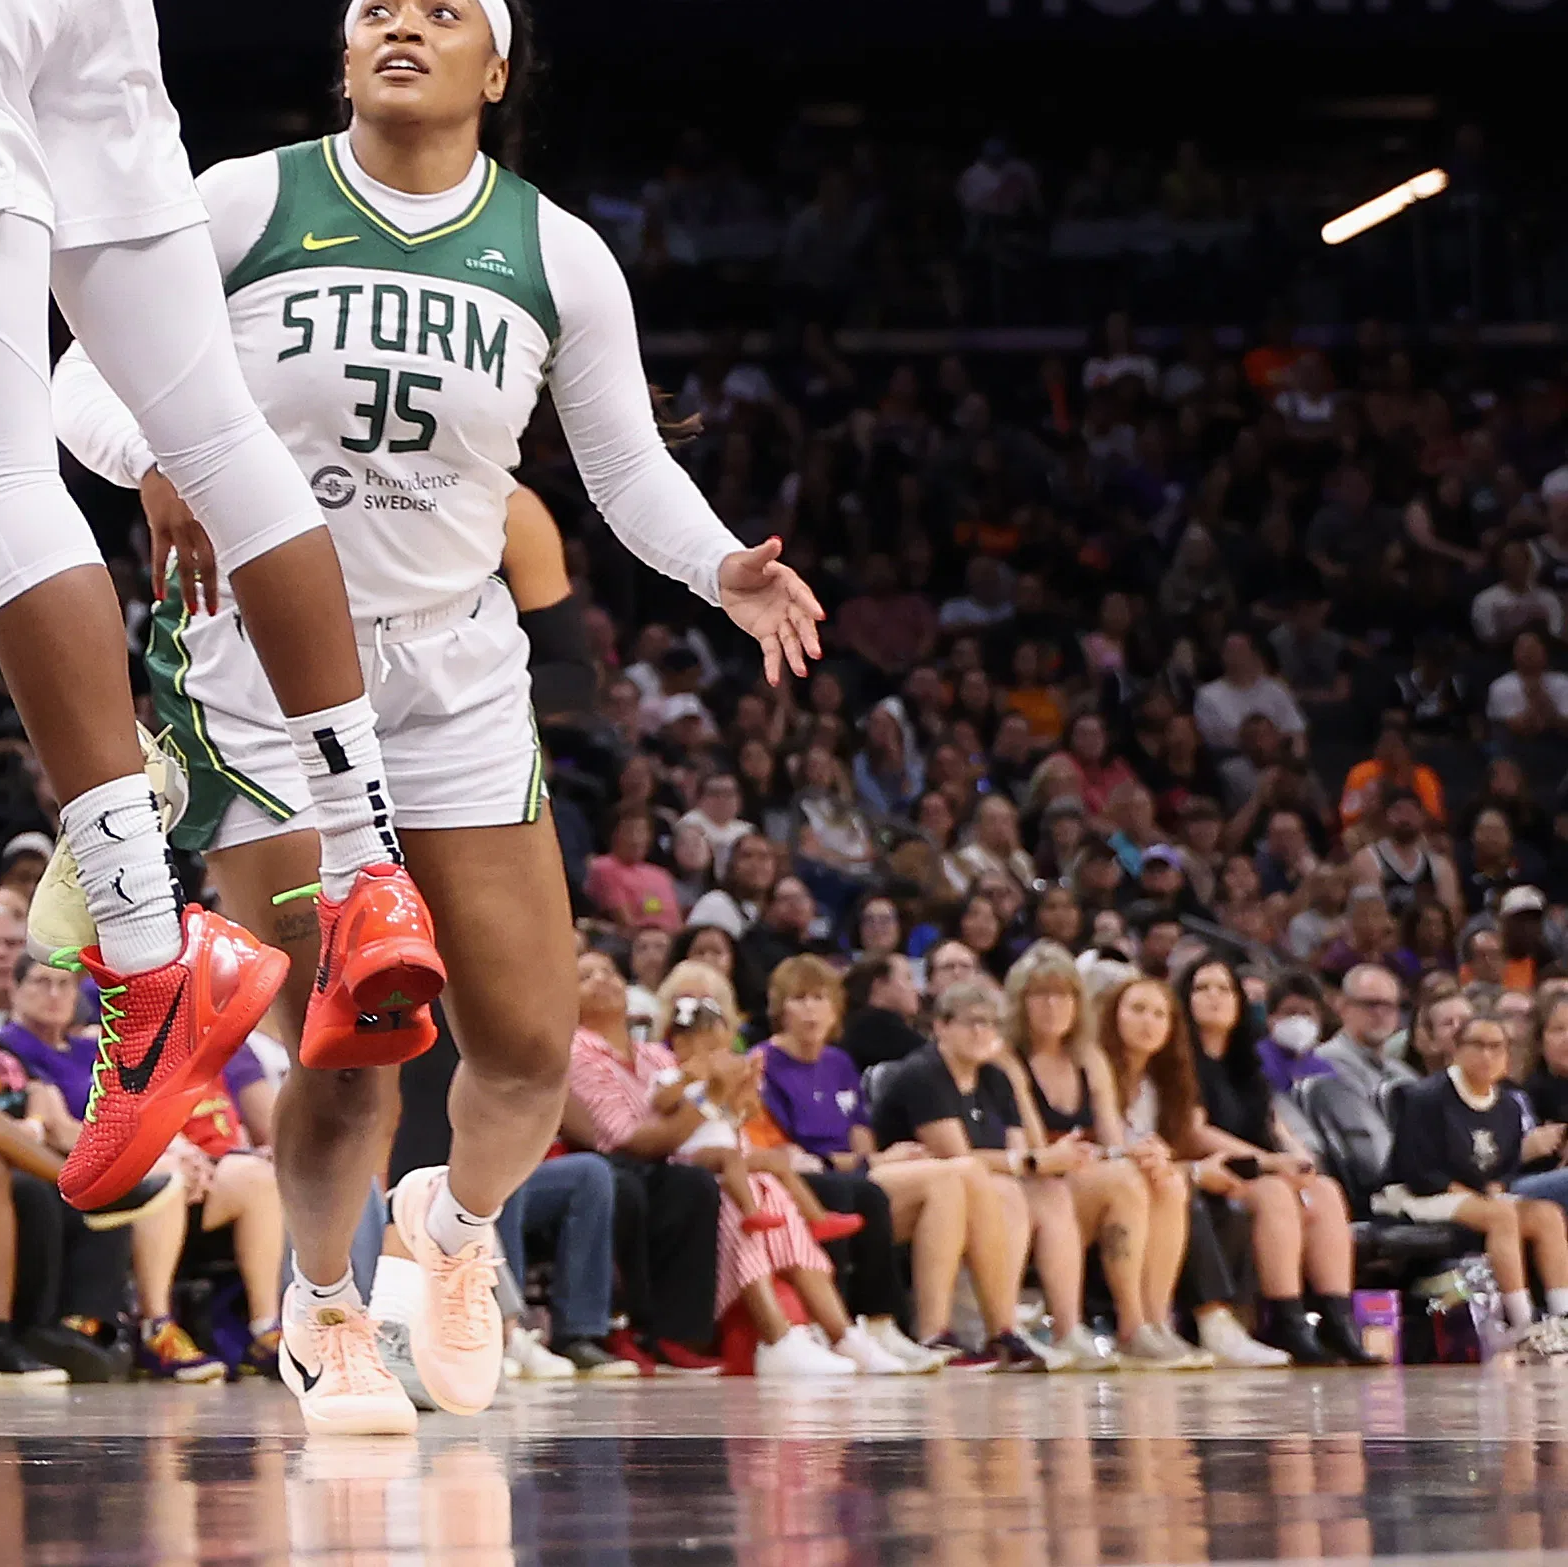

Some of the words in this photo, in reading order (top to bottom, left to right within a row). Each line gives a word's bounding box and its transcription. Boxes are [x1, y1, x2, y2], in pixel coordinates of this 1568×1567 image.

[277, 284, 511, 391] STORM
[340, 364, 443, 453] 35
[364, 467, 461, 492] Providence
[364, 495, 438, 512] SWEDISH
